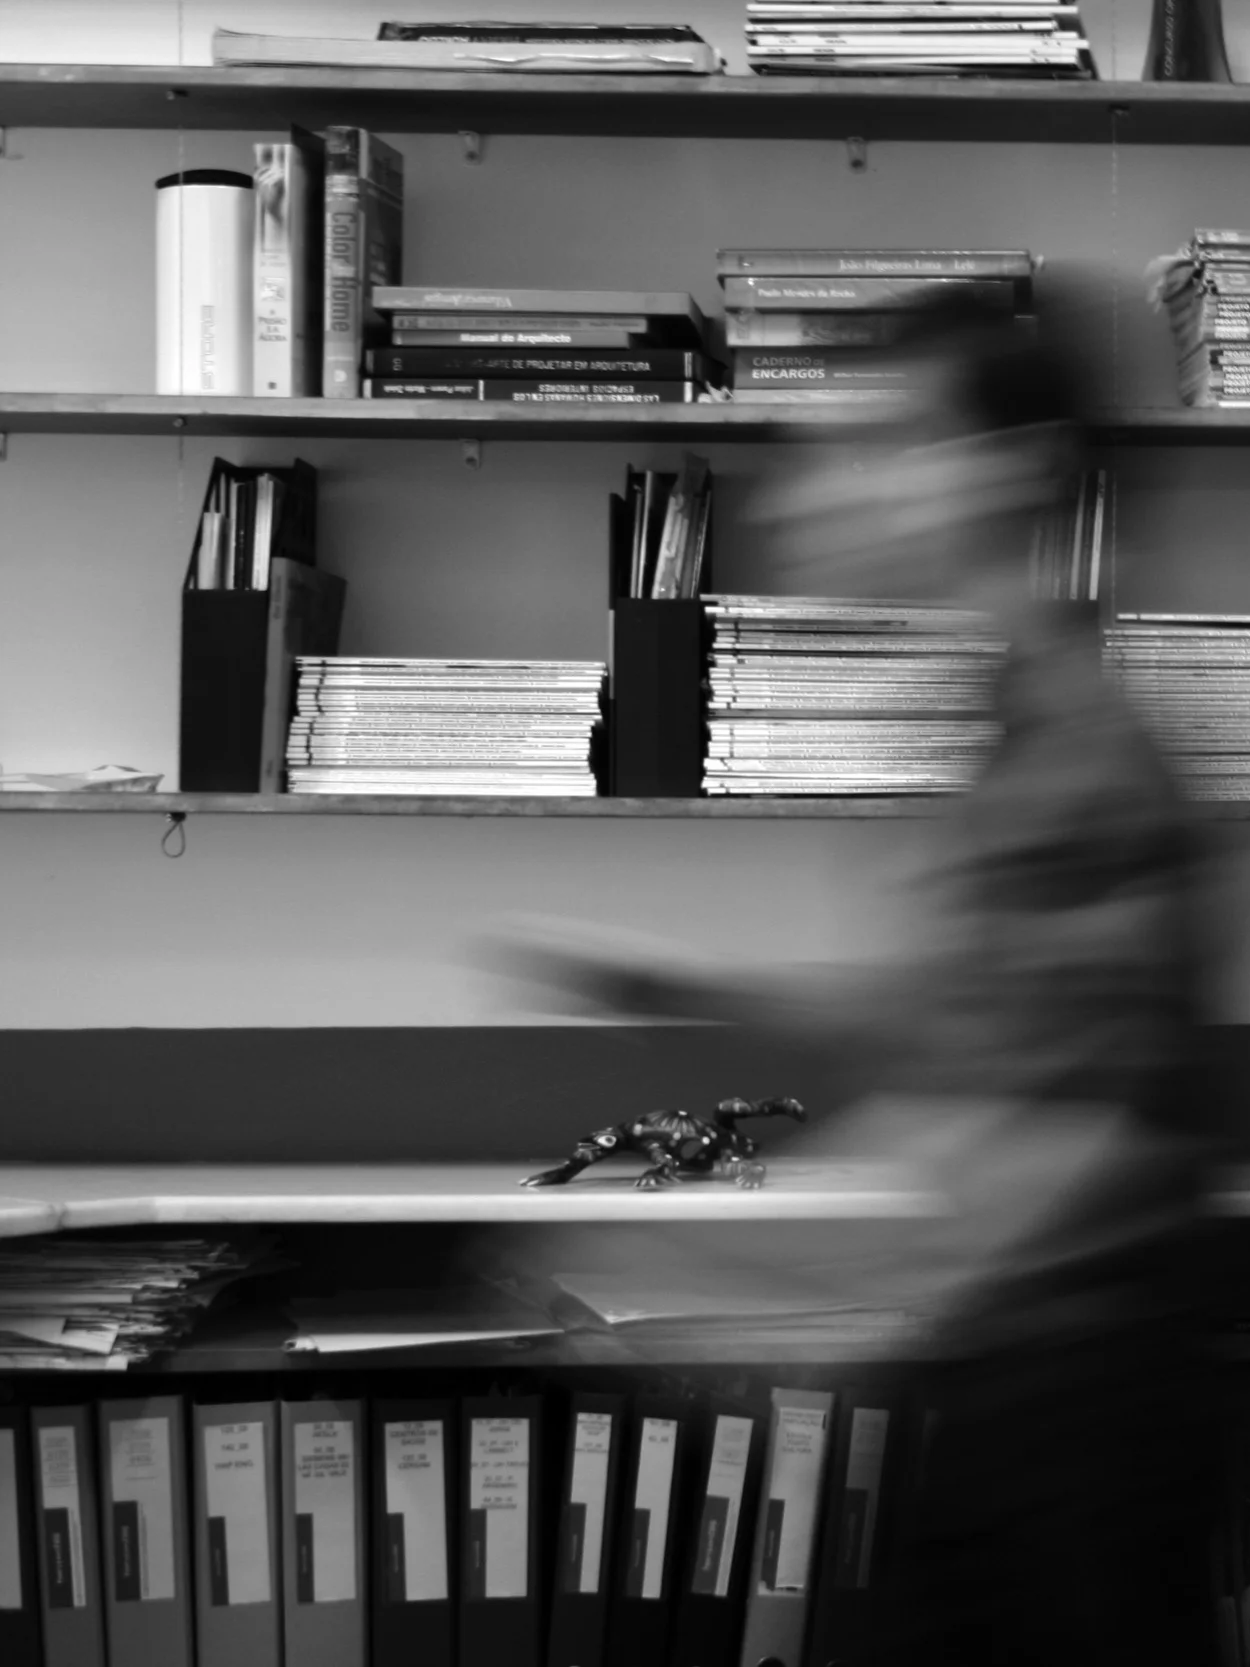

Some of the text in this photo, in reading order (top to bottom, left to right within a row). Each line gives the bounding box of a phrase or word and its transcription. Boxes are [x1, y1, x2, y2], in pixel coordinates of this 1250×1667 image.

[331, 212, 358, 332] Color Home
[512, 359, 525, 369] DE
[526, 359, 573, 370] PROJETAR
[574, 360, 588, 371] EM
[589, 361, 651, 372] ARQUITETURA
[752, 356, 812, 368] CADERNO
[752, 368, 825, 380] ENCARGOS
